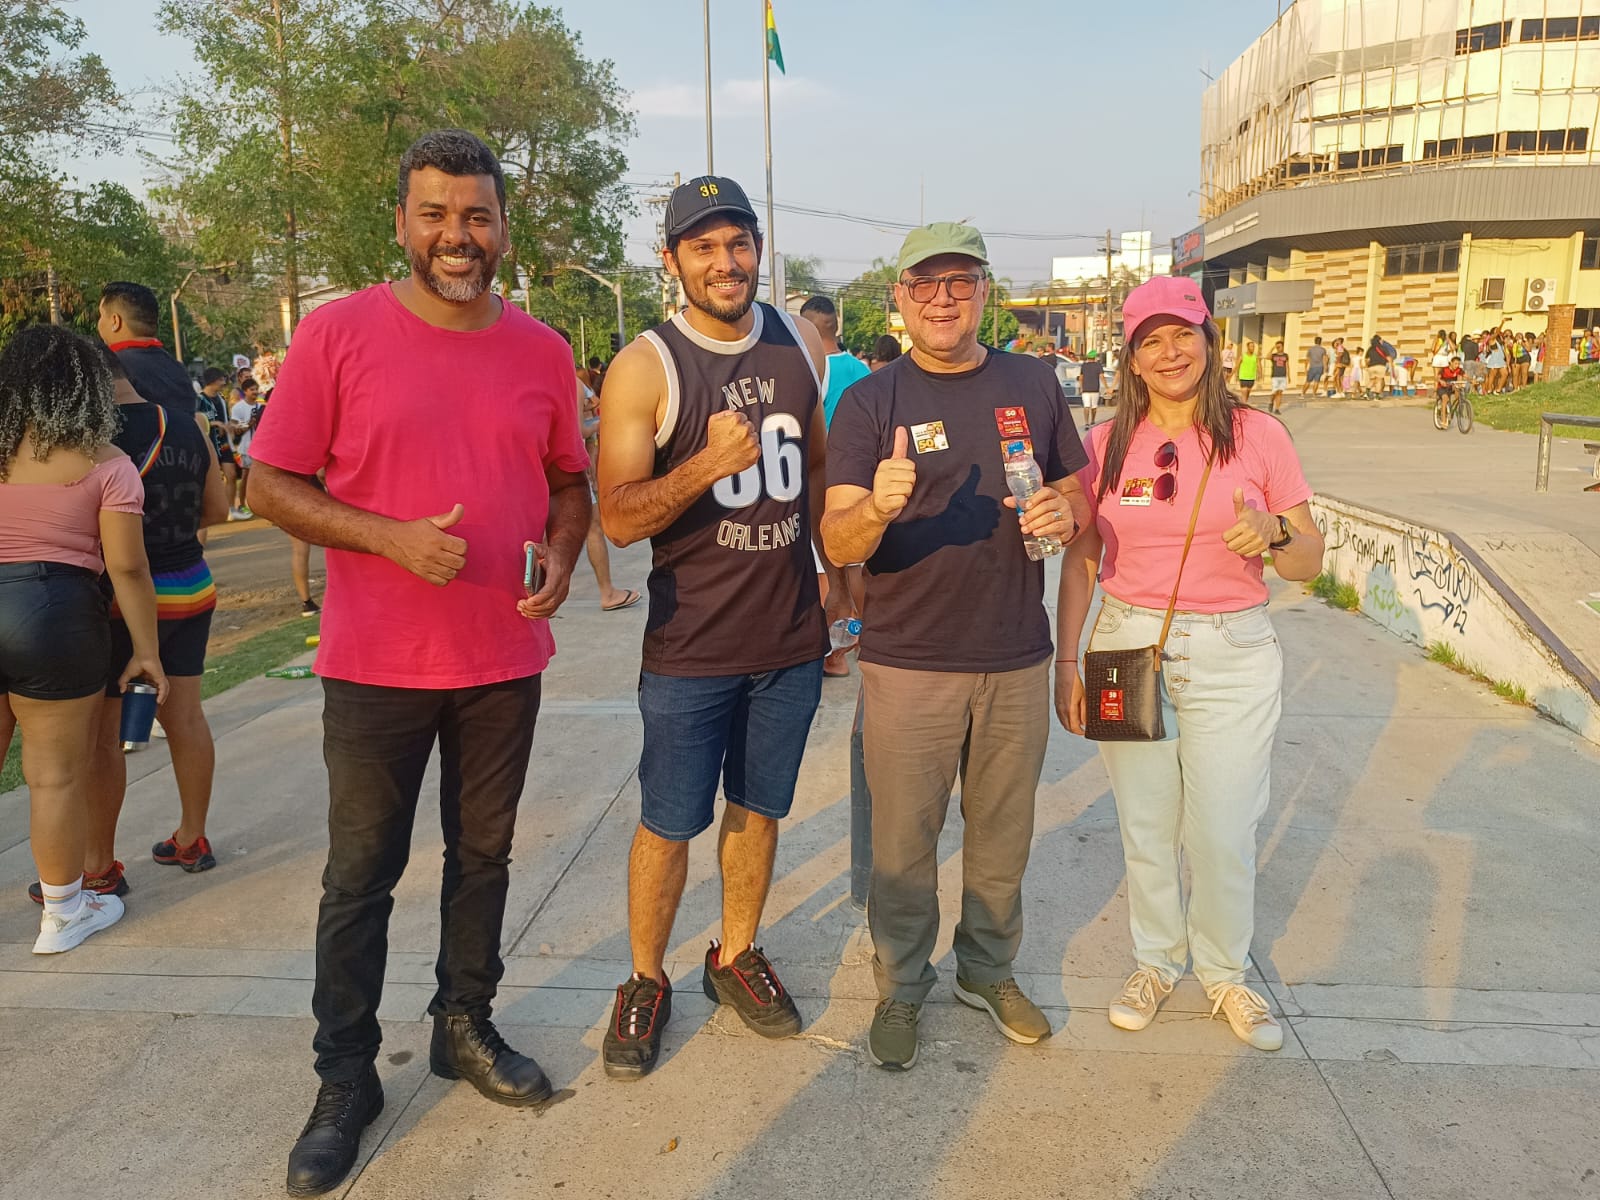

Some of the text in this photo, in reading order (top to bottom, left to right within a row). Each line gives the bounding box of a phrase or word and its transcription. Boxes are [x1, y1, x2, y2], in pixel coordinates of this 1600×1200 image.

[700, 184, 718, 197] 36
[721, 376, 775, 411] NEW
[716, 512, 800, 550] ORLEANS
